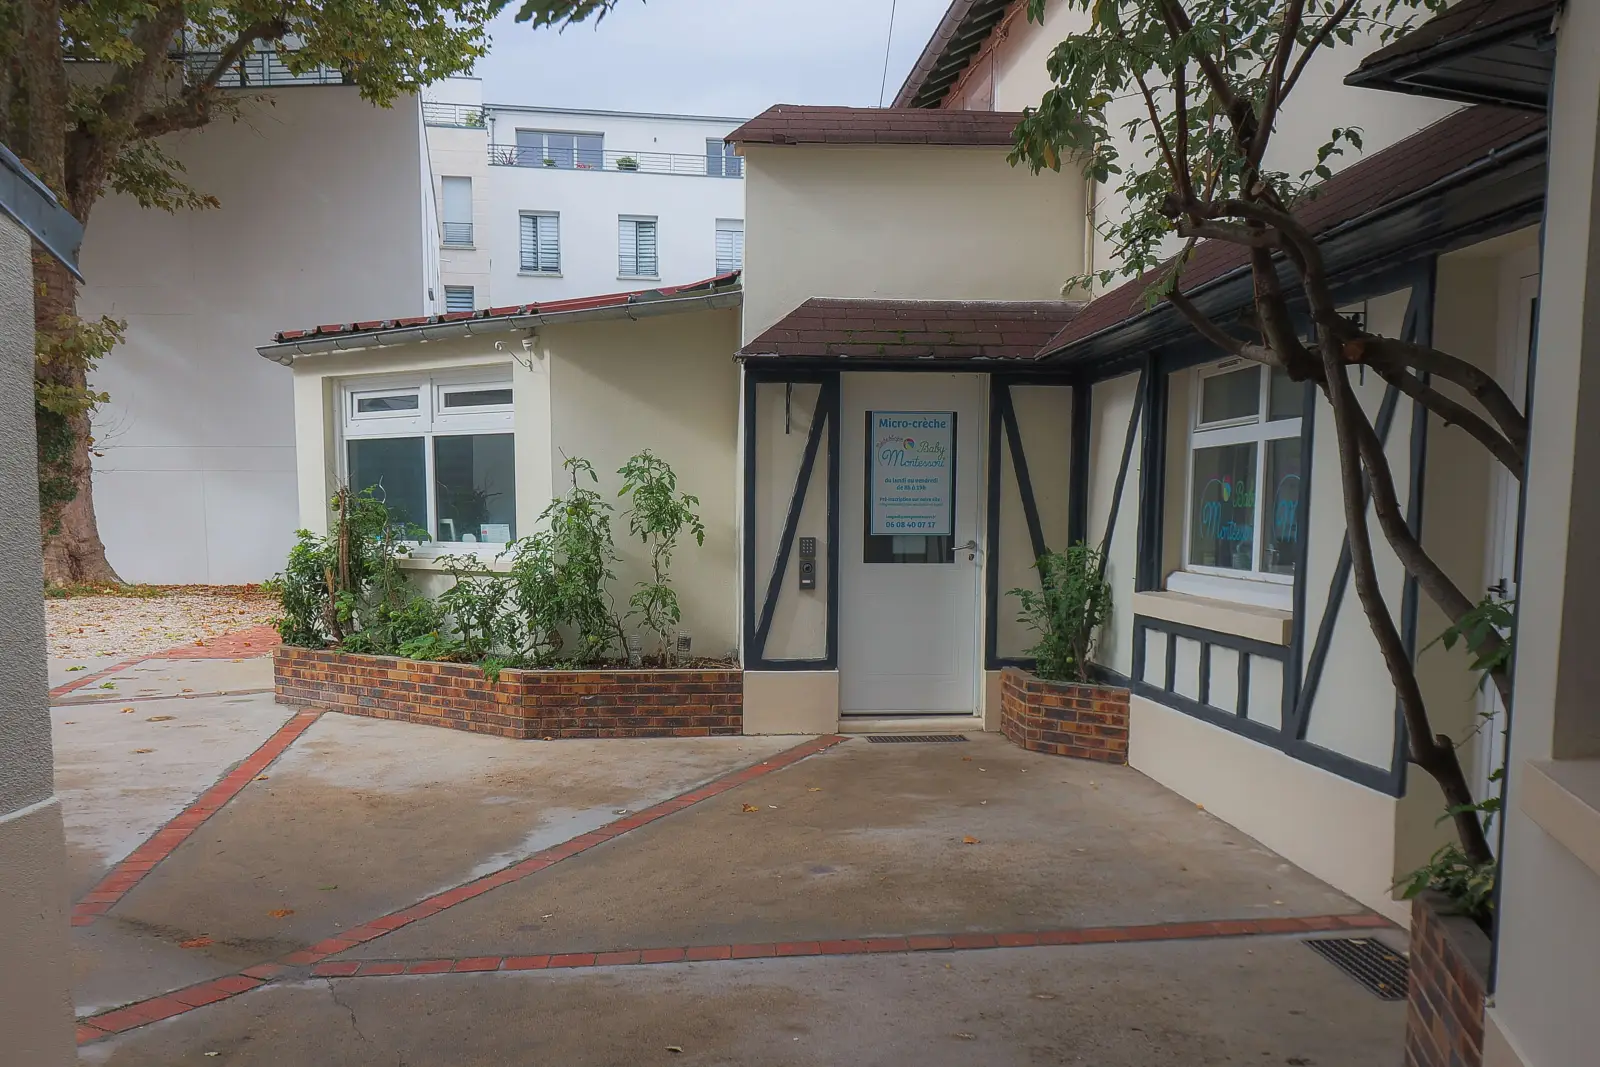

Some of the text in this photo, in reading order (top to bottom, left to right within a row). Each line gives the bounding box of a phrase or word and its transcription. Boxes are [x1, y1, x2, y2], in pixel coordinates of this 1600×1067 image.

[879, 417, 946, 428] Micro-crèche
[881, 449, 945, 467] Montessori
[917, 441, 945, 460] Baby
[1233, 480, 1255, 508] Bab
